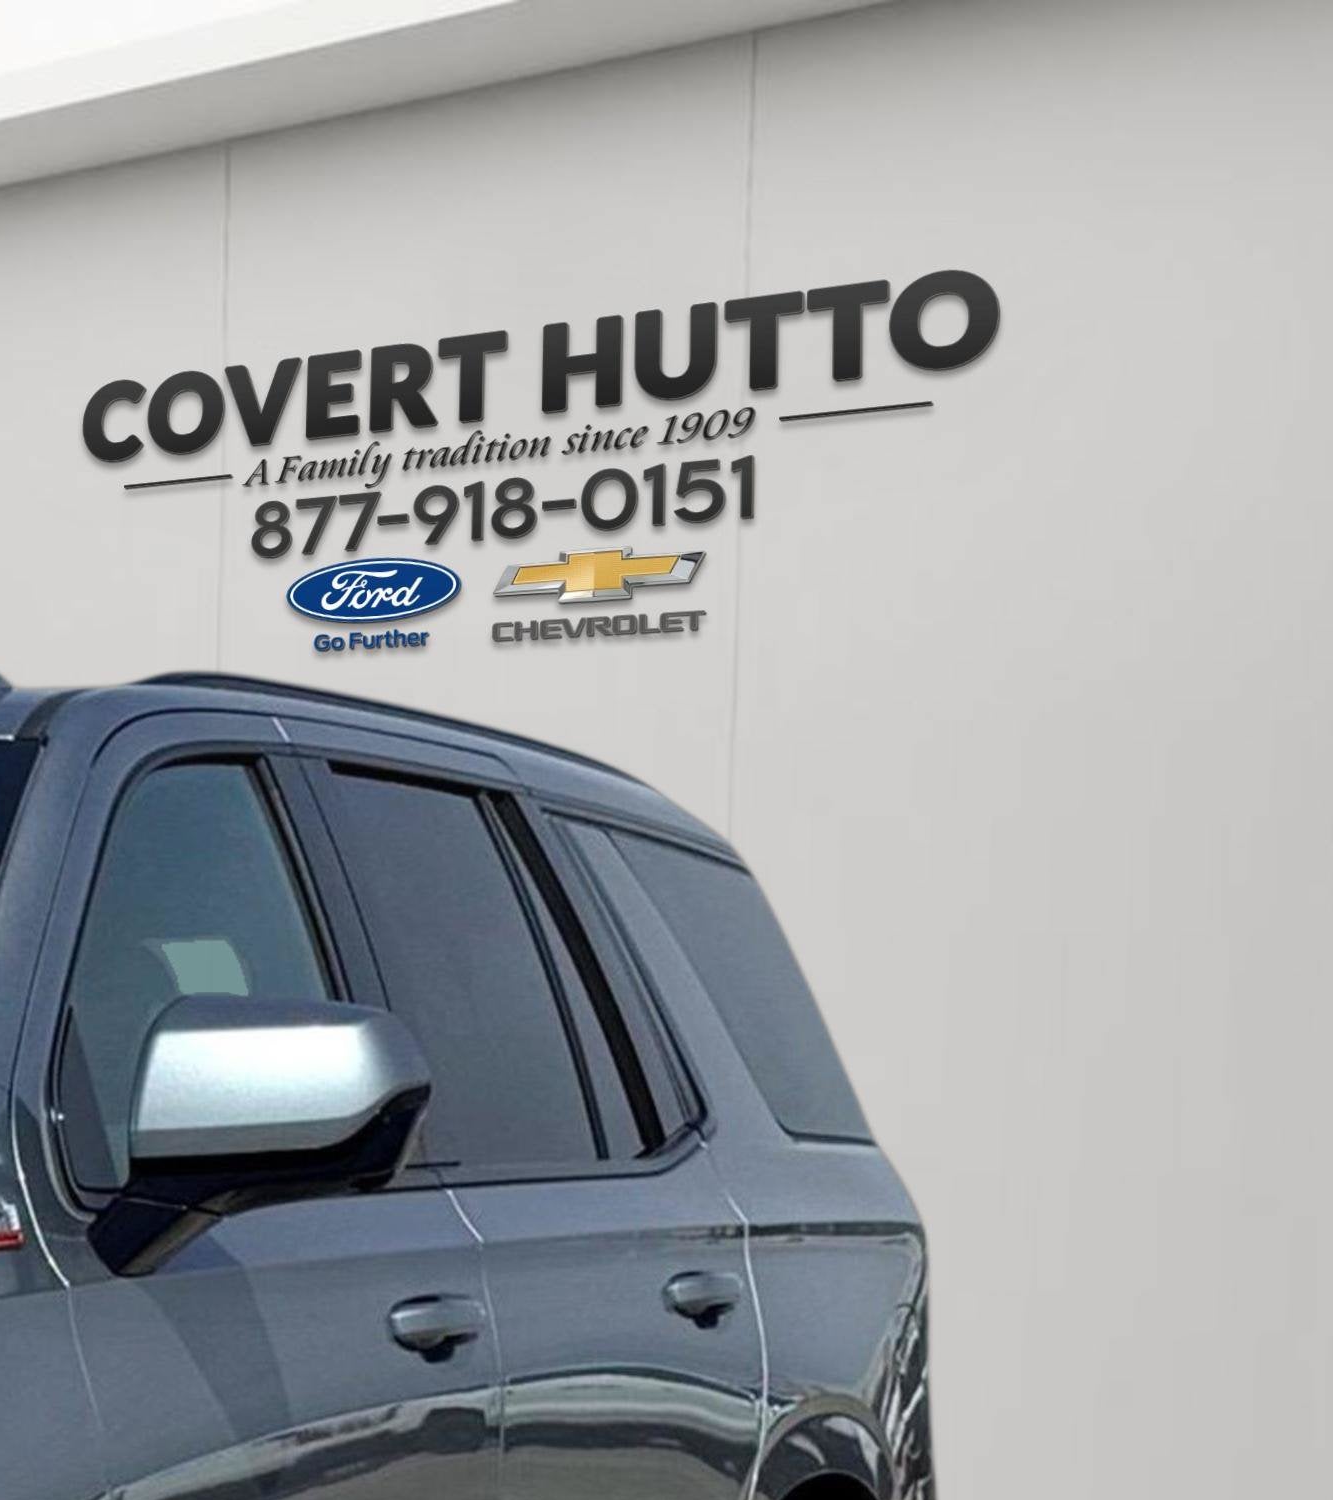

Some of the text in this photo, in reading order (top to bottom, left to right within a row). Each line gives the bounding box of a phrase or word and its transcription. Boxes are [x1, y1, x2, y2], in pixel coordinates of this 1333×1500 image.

[82, 270, 1000, 463] COVERT HUTTO
[244, 407, 756, 487] A Family tradition since 1909
[251, 455, 755, 558] 877-918-0151
[321, 570, 422, 609] Ford
[314, 629, 430, 652] Go Further
[492, 610, 707, 644] CHEVROLET
